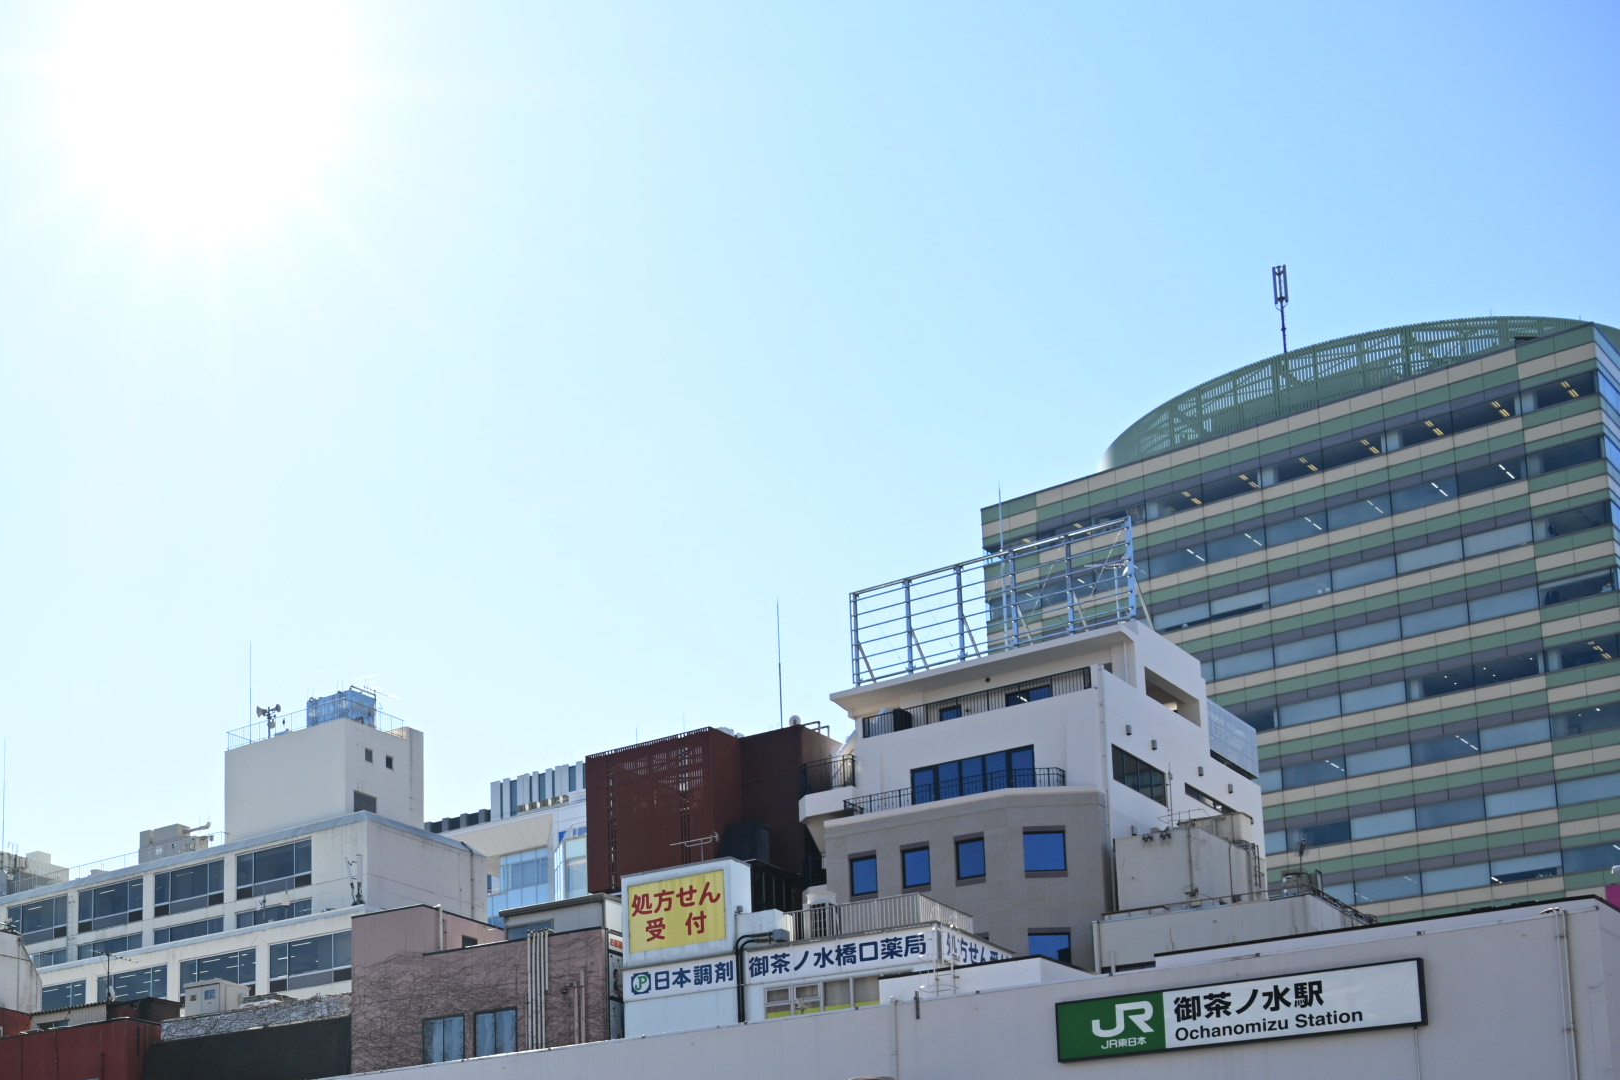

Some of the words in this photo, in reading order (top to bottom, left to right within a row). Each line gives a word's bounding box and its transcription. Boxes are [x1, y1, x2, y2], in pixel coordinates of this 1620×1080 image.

[631, 881, 721, 917] 処方せん
[748, 934, 927, 977] 御茶ノ水橋口薬局
[654, 960, 734, 991] 日本調剤
[1091, 1000, 1155, 1038] JR
[1173, 980, 1325, 1023] 御茶ノ水駅
[1101, 1036, 1148, 1050] JR東日本
[1175, 1018, 1289, 1042] Ochanomizu
[1295, 1010, 1364, 1029] Station
